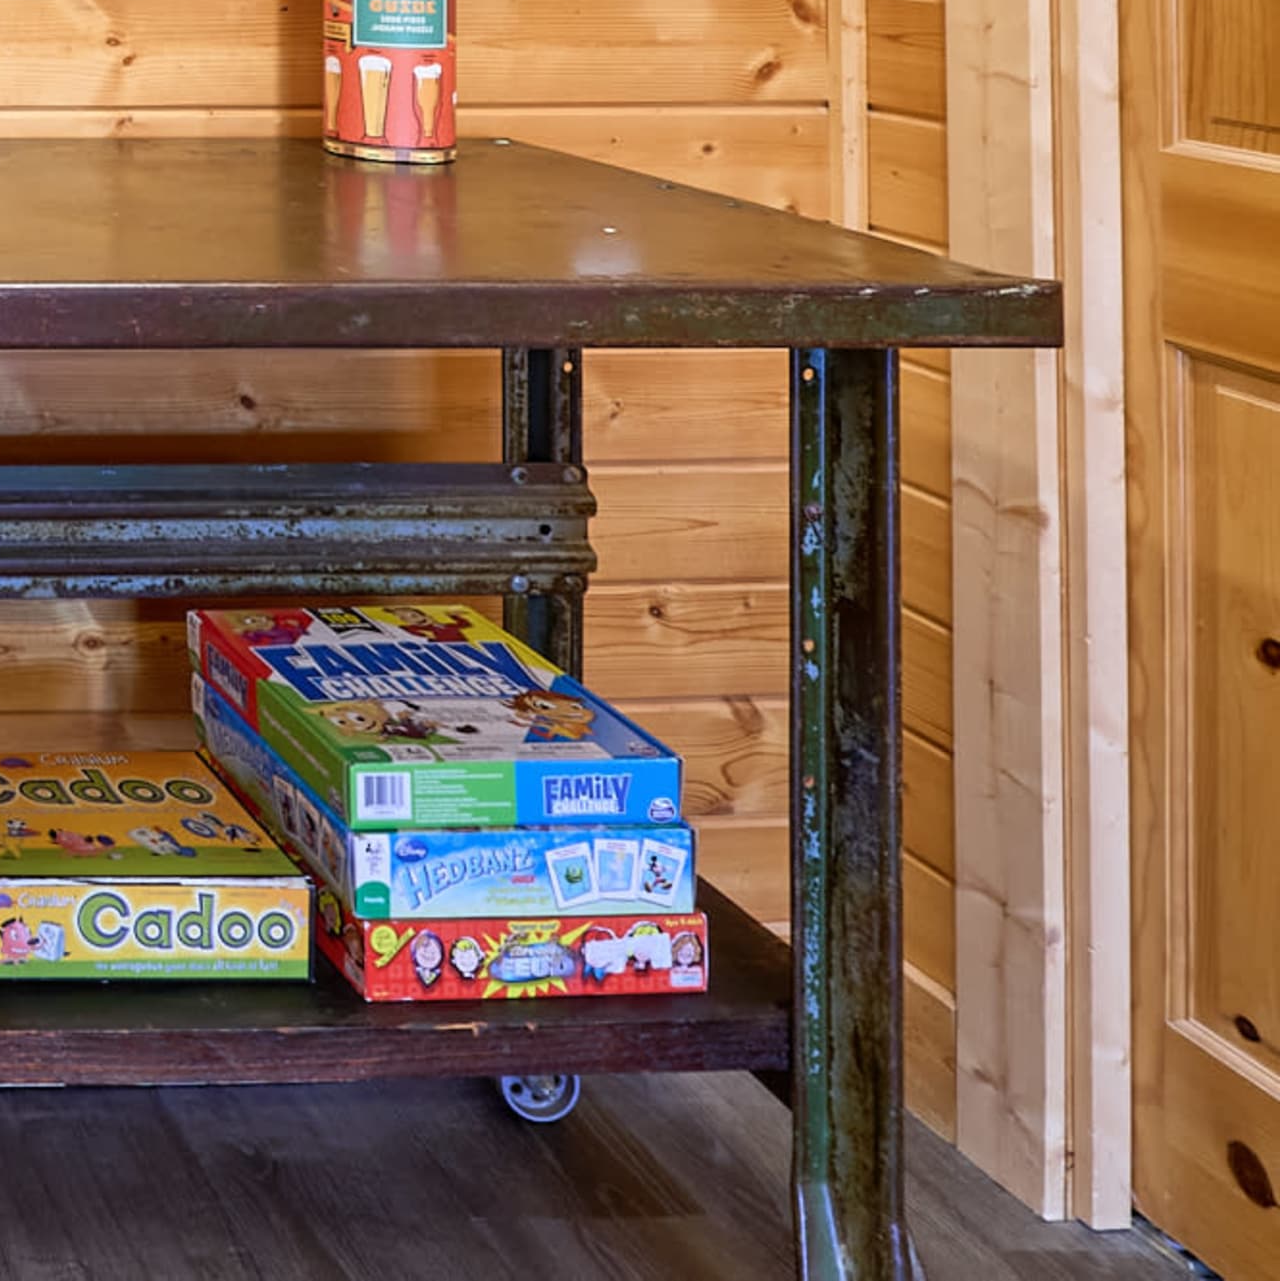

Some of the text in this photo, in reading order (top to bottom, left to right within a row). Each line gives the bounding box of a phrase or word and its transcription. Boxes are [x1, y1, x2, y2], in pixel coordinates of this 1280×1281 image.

[369, 0, 436, 14] GUIDE
[319, 674, 523, 699] CHALLENGE
[402, 846, 536, 910] HEDBANZ
[76, 891, 295, 950] Cadoo
